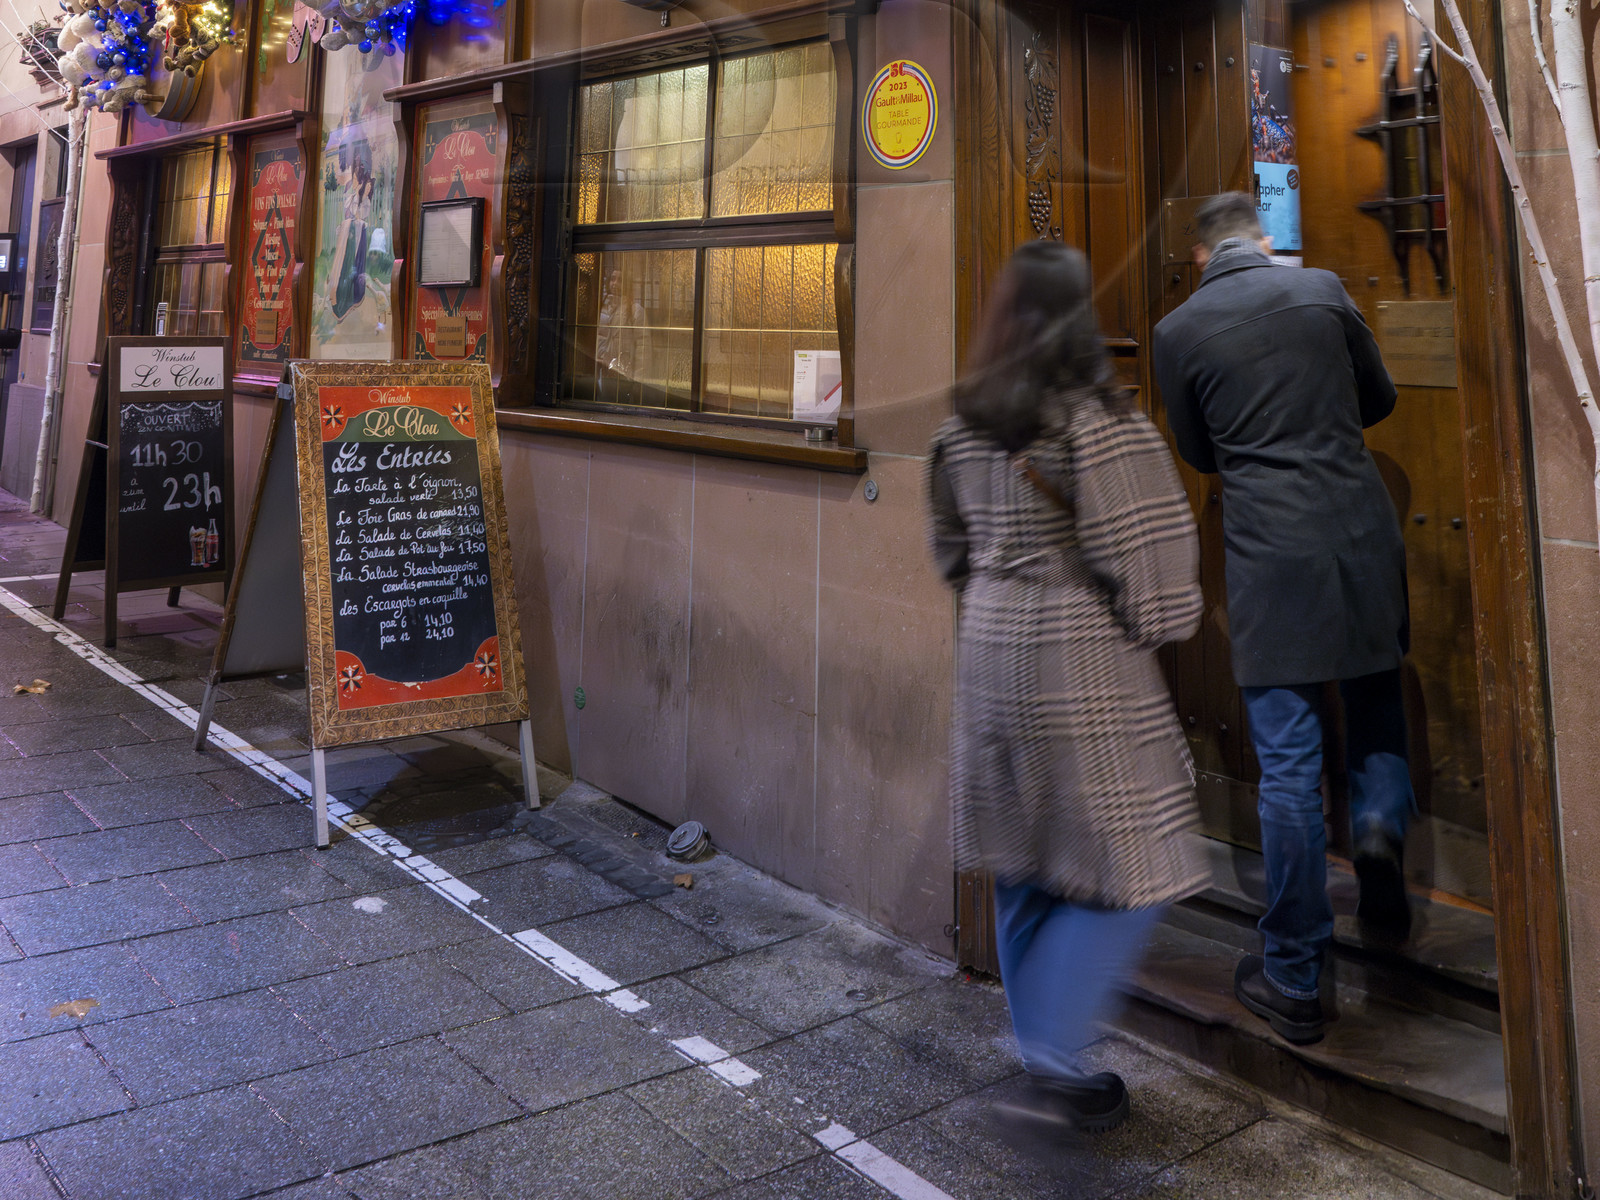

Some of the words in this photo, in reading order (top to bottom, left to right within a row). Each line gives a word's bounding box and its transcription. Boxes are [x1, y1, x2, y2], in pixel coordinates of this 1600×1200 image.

[889, 81, 908, 92] 2023
[876, 116, 922, 130] GOURMANDE
[888, 109, 909, 119] TABLE
[1259, 184, 1285, 198] apher
[1256, 202, 1272, 212] ear
[151, 348, 196, 363] Winstub
[130, 364, 162, 388] Le
[169, 363, 215, 388] Clou
[368, 388, 412, 405] Winstub
[144, 411, 191, 426] OUVERT
[362, 409, 396, 438] Le
[393, 405, 440, 442] Clou
[130, 442, 167, 467] 11h
[170, 439, 203, 465] 30
[331, 441, 367, 474] Les
[376, 443, 452, 471] Entrées
[162, 471, 222, 512] 23h
[333, 478, 350, 495] La
[354, 476, 388, 493] Tarte
[393, 477, 403, 490] à
[368, 492, 406, 505] salade
[451, 486, 478, 501] 13,50
[119, 498, 147, 513] until
[335, 509, 352, 527] Le
[357, 507, 384, 526] Foie
[416, 507, 428, 520] de
[429, 506, 457, 518] canard
[456, 504, 480, 518] 21,90
[335, 529, 352, 546] La
[357, 526, 396, 544] Salade
[400, 528, 412, 540] de
[457, 523, 485, 537] 11,40
[335, 548, 353, 563] La
[358, 546, 396, 561] Salade
[398, 544, 409, 556] de
[458, 539, 486, 555] 17,50
[336, 566, 354, 583] La
[358, 564, 399, 583] Salade
[402, 560, 479, 581] Strasbourgeoise
[462, 573, 489, 588] 14,40
[364, 595, 417, 620] Escargots
[418, 596, 430, 606] en
[431, 586, 469, 611] coquille
[379, 620, 398, 636] par
[400, 615, 407, 629] 6
[423, 612, 453, 628] 14,10
[380, 634, 397, 651] par
[399, 631, 411, 642] 12
[425, 626, 455, 641] 24,10
